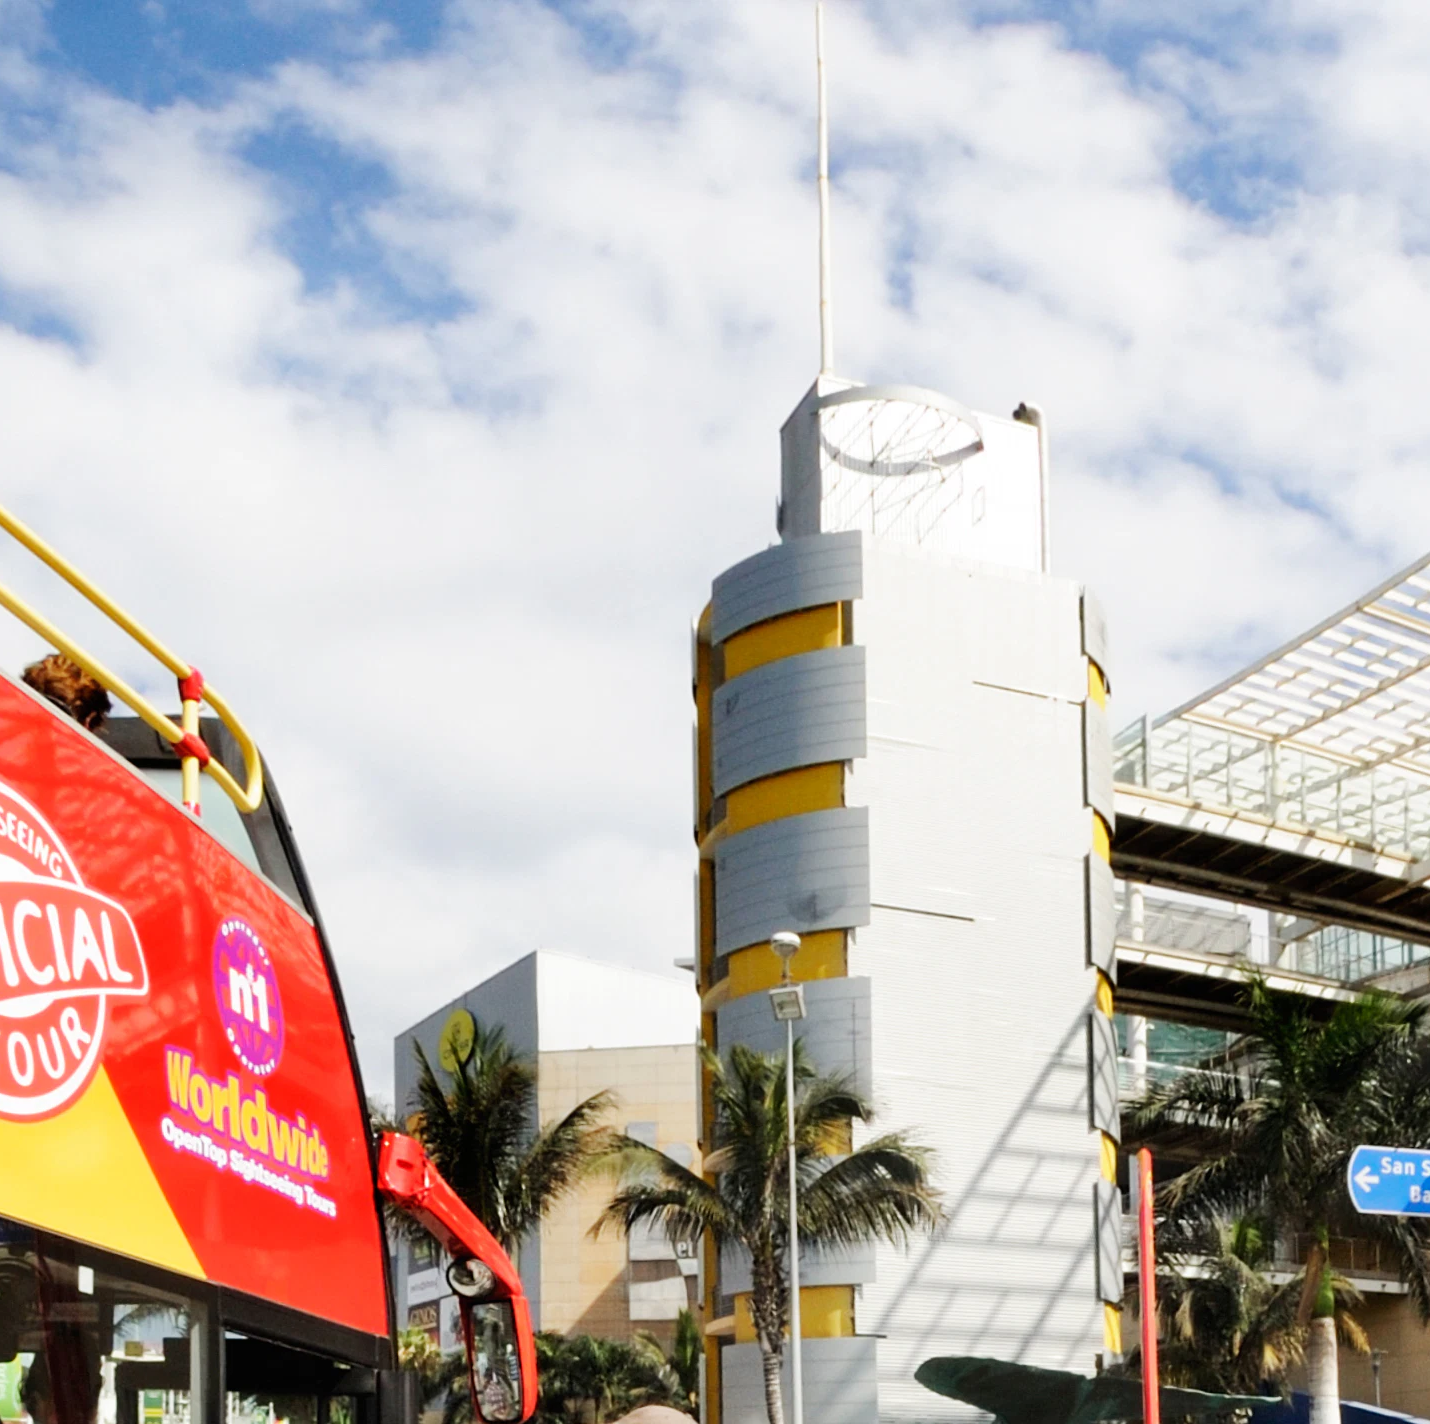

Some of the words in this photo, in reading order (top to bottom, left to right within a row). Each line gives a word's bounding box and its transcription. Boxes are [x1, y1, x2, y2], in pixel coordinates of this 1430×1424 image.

[166, 1049, 330, 1179] Worldwide
[161, 1118, 228, 1168] OpenTop
[230, 1150, 304, 1204] Sightseeing
[304, 1180, 337, 1217] Tours
[1380, 1157, 1416, 1177] San
